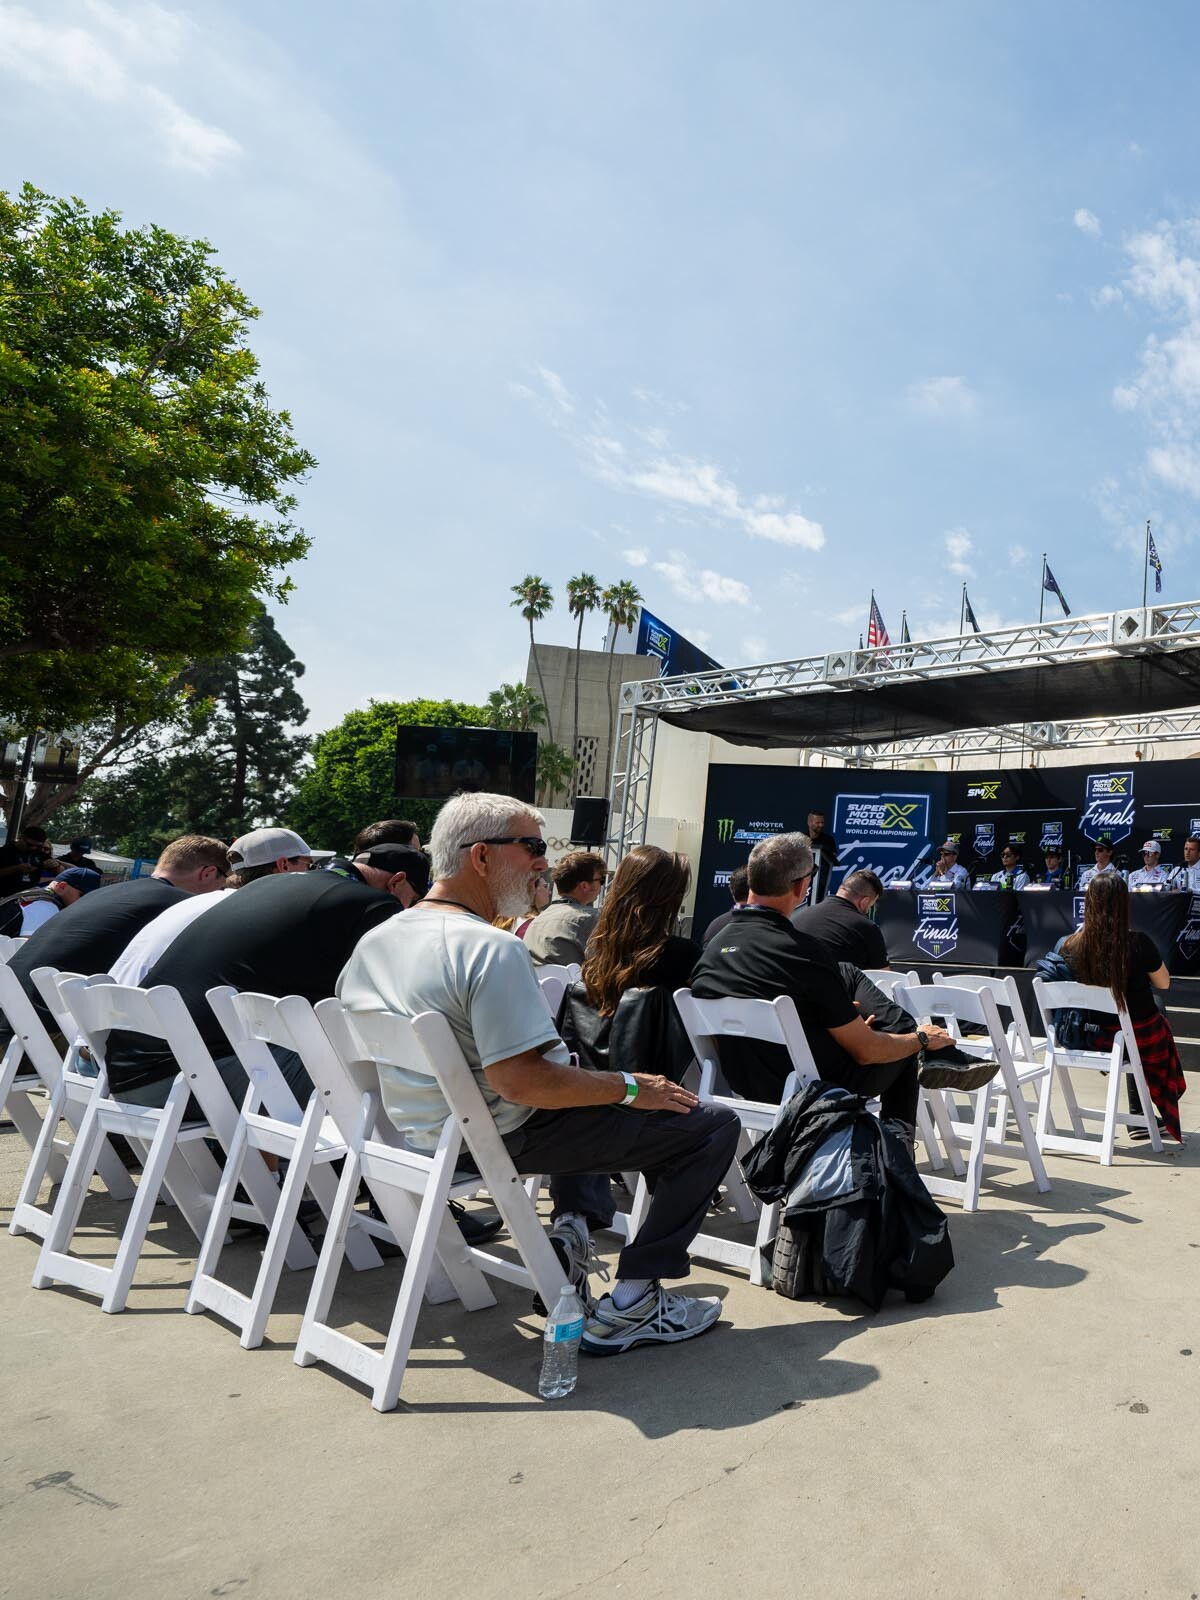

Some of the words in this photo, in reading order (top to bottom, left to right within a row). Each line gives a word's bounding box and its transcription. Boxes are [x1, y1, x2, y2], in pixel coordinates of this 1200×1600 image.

[967, 785, 998, 799] SMX
[847, 804, 887, 812] SUPER
[849, 811, 885, 819] MOTO
[1078, 798, 1135, 829] Finals
[749, 821, 784, 829] MONSTER
[845, 818, 885, 826] CROSS
[912, 917, 959, 941] Finals
